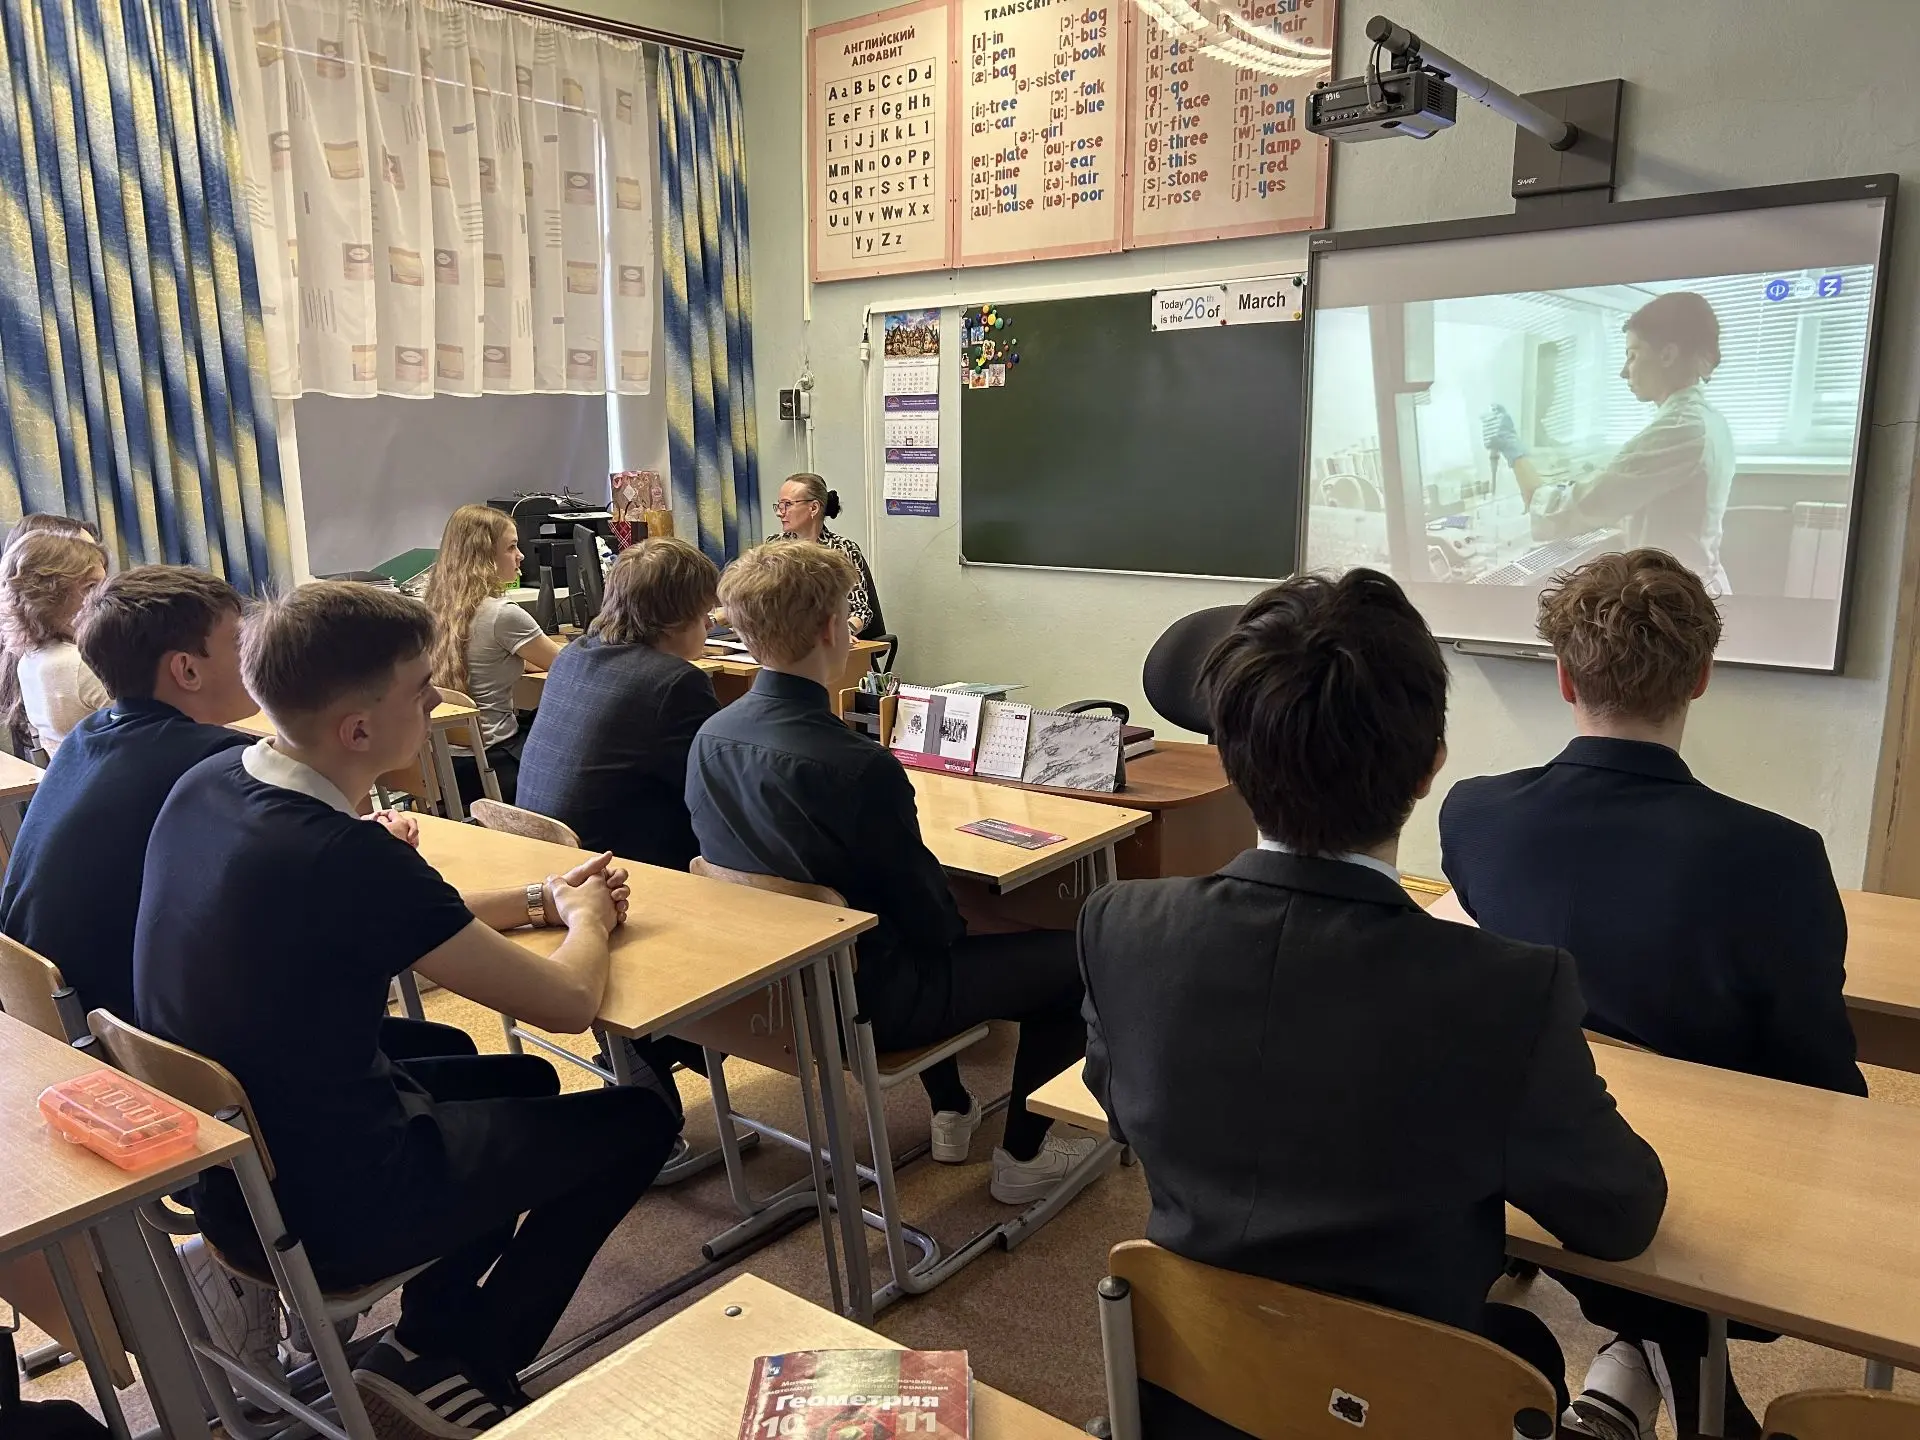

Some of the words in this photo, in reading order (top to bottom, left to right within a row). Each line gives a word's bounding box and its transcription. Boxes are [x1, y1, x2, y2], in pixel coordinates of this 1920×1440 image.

[984, 0, 1067, 21] TRANSCRI
[843, 25, 915, 55] АНГЛИЙСКИЙ
[852, 45, 903, 67] АЛФАВИТ
[1160, 300, 1184, 310] Today
[1238, 291, 1286, 310] March
[1160, 315, 1168, 324] is
[1170, 314, 1182, 323] the
[1208, 305, 1220, 318] of
[775, 1394, 939, 1411] Геометрия
[899, 1412, 936, 1432] 11
